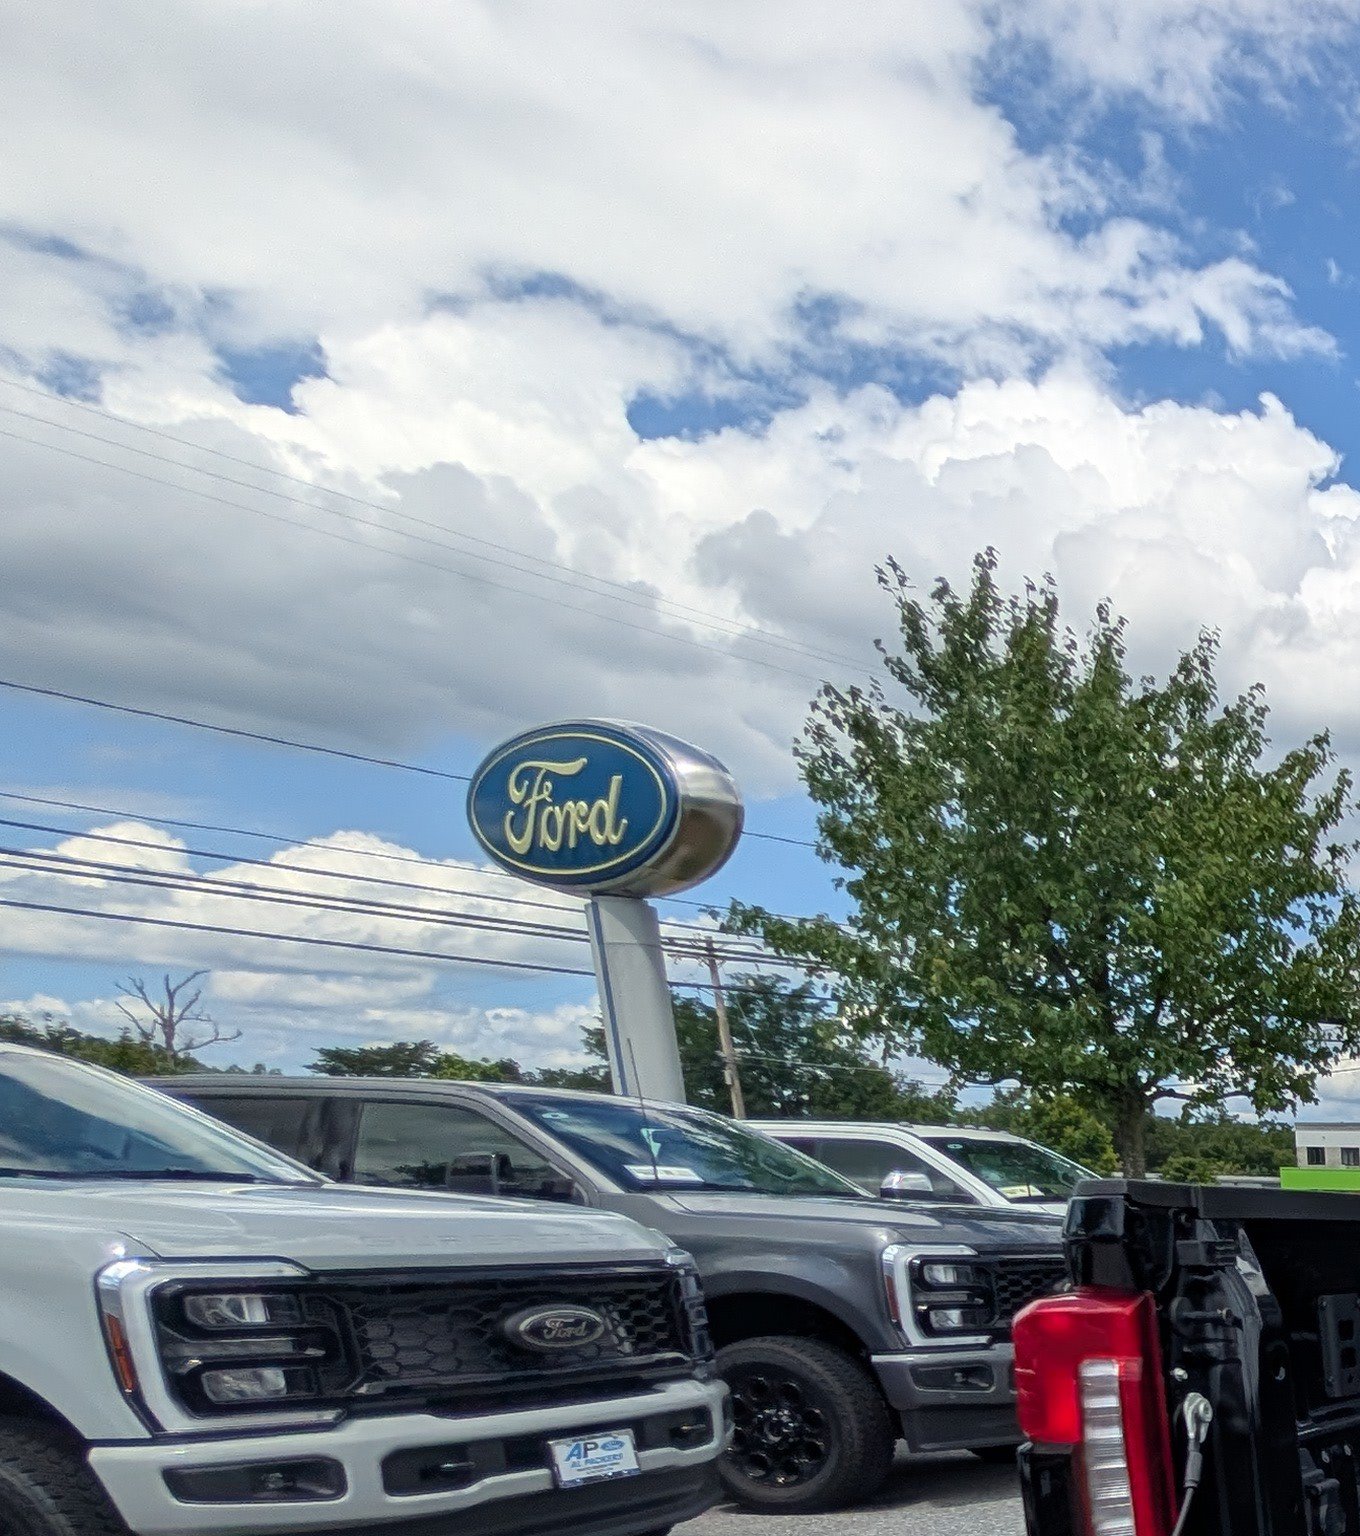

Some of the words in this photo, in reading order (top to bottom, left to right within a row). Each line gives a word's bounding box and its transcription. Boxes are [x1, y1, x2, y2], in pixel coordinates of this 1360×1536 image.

[504, 758, 628, 855] Ford
[543, 1318, 587, 1339] Ford
[565, 1443, 599, 1462] AP
